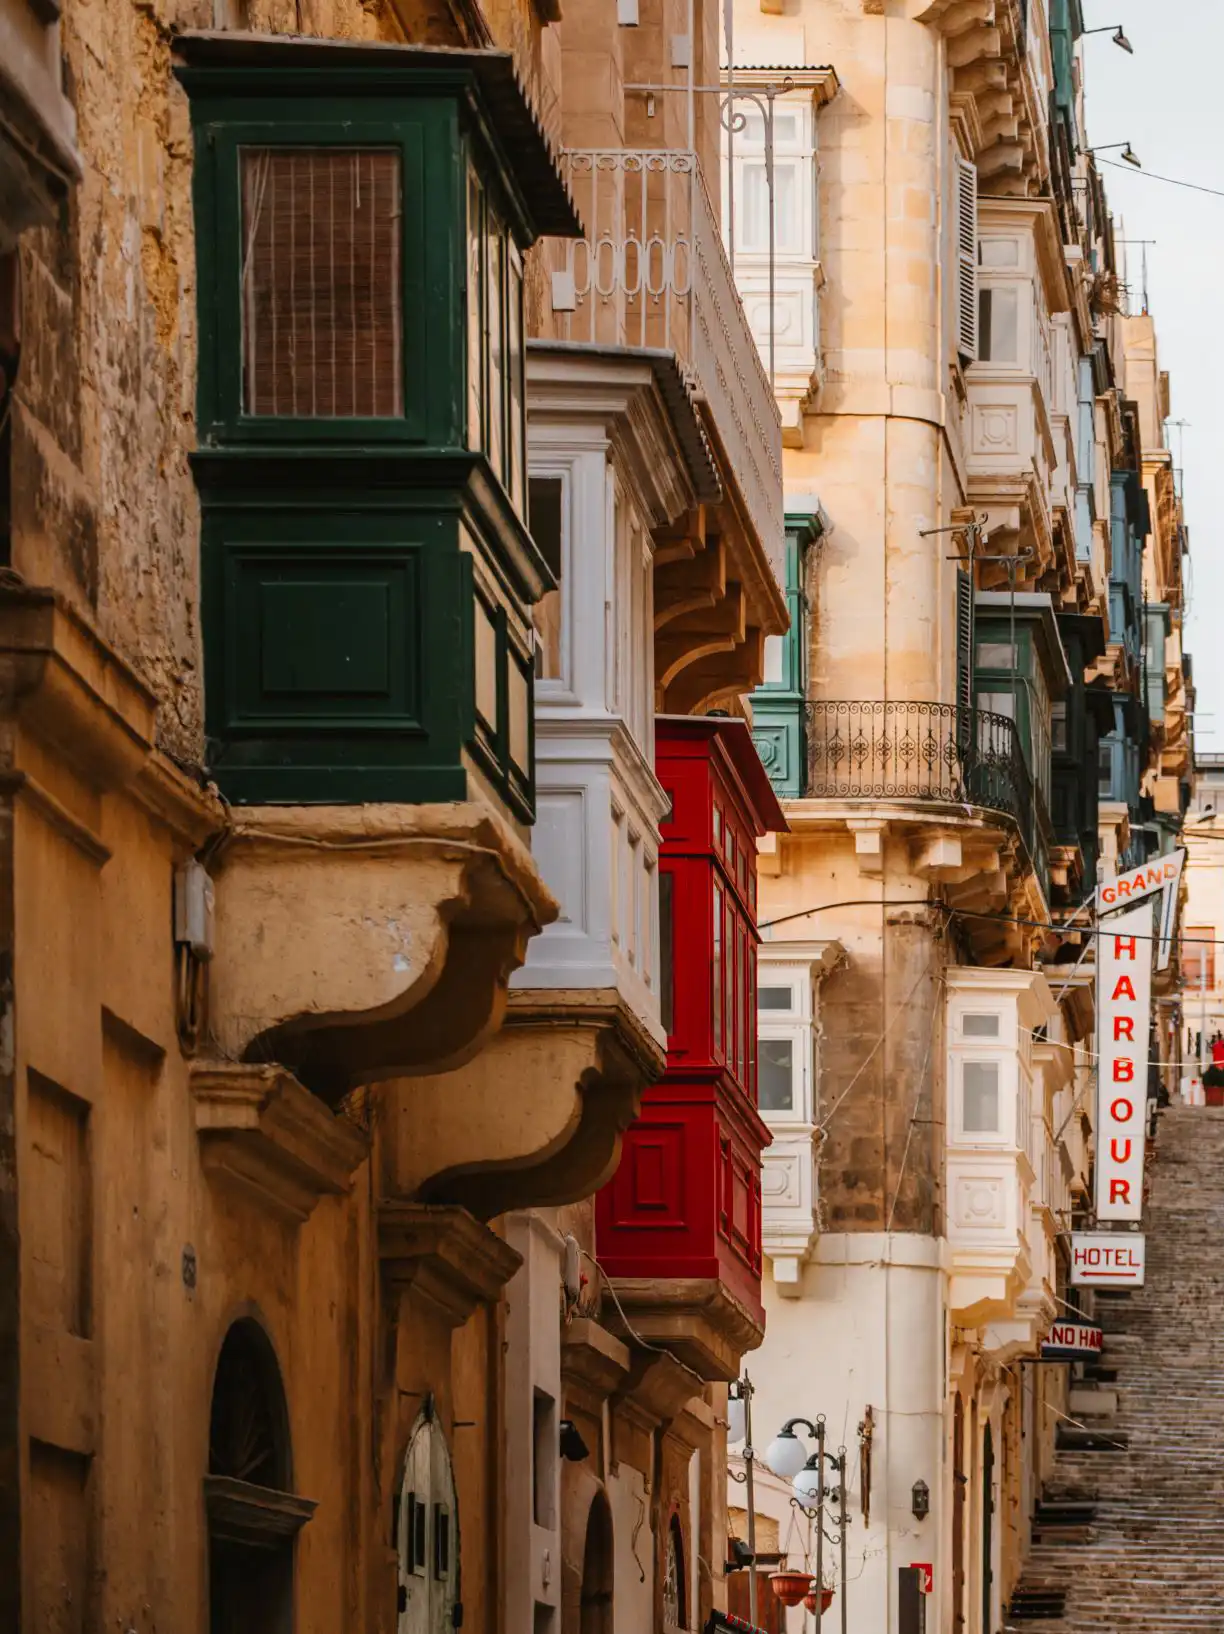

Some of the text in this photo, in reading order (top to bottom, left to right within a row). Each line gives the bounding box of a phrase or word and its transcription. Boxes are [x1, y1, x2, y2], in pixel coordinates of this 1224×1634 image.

[1102, 863, 1177, 903] GRAND
[1109, 935, 1136, 1204] HARBOUR
[1074, 1247, 1140, 1267] HOTEL
